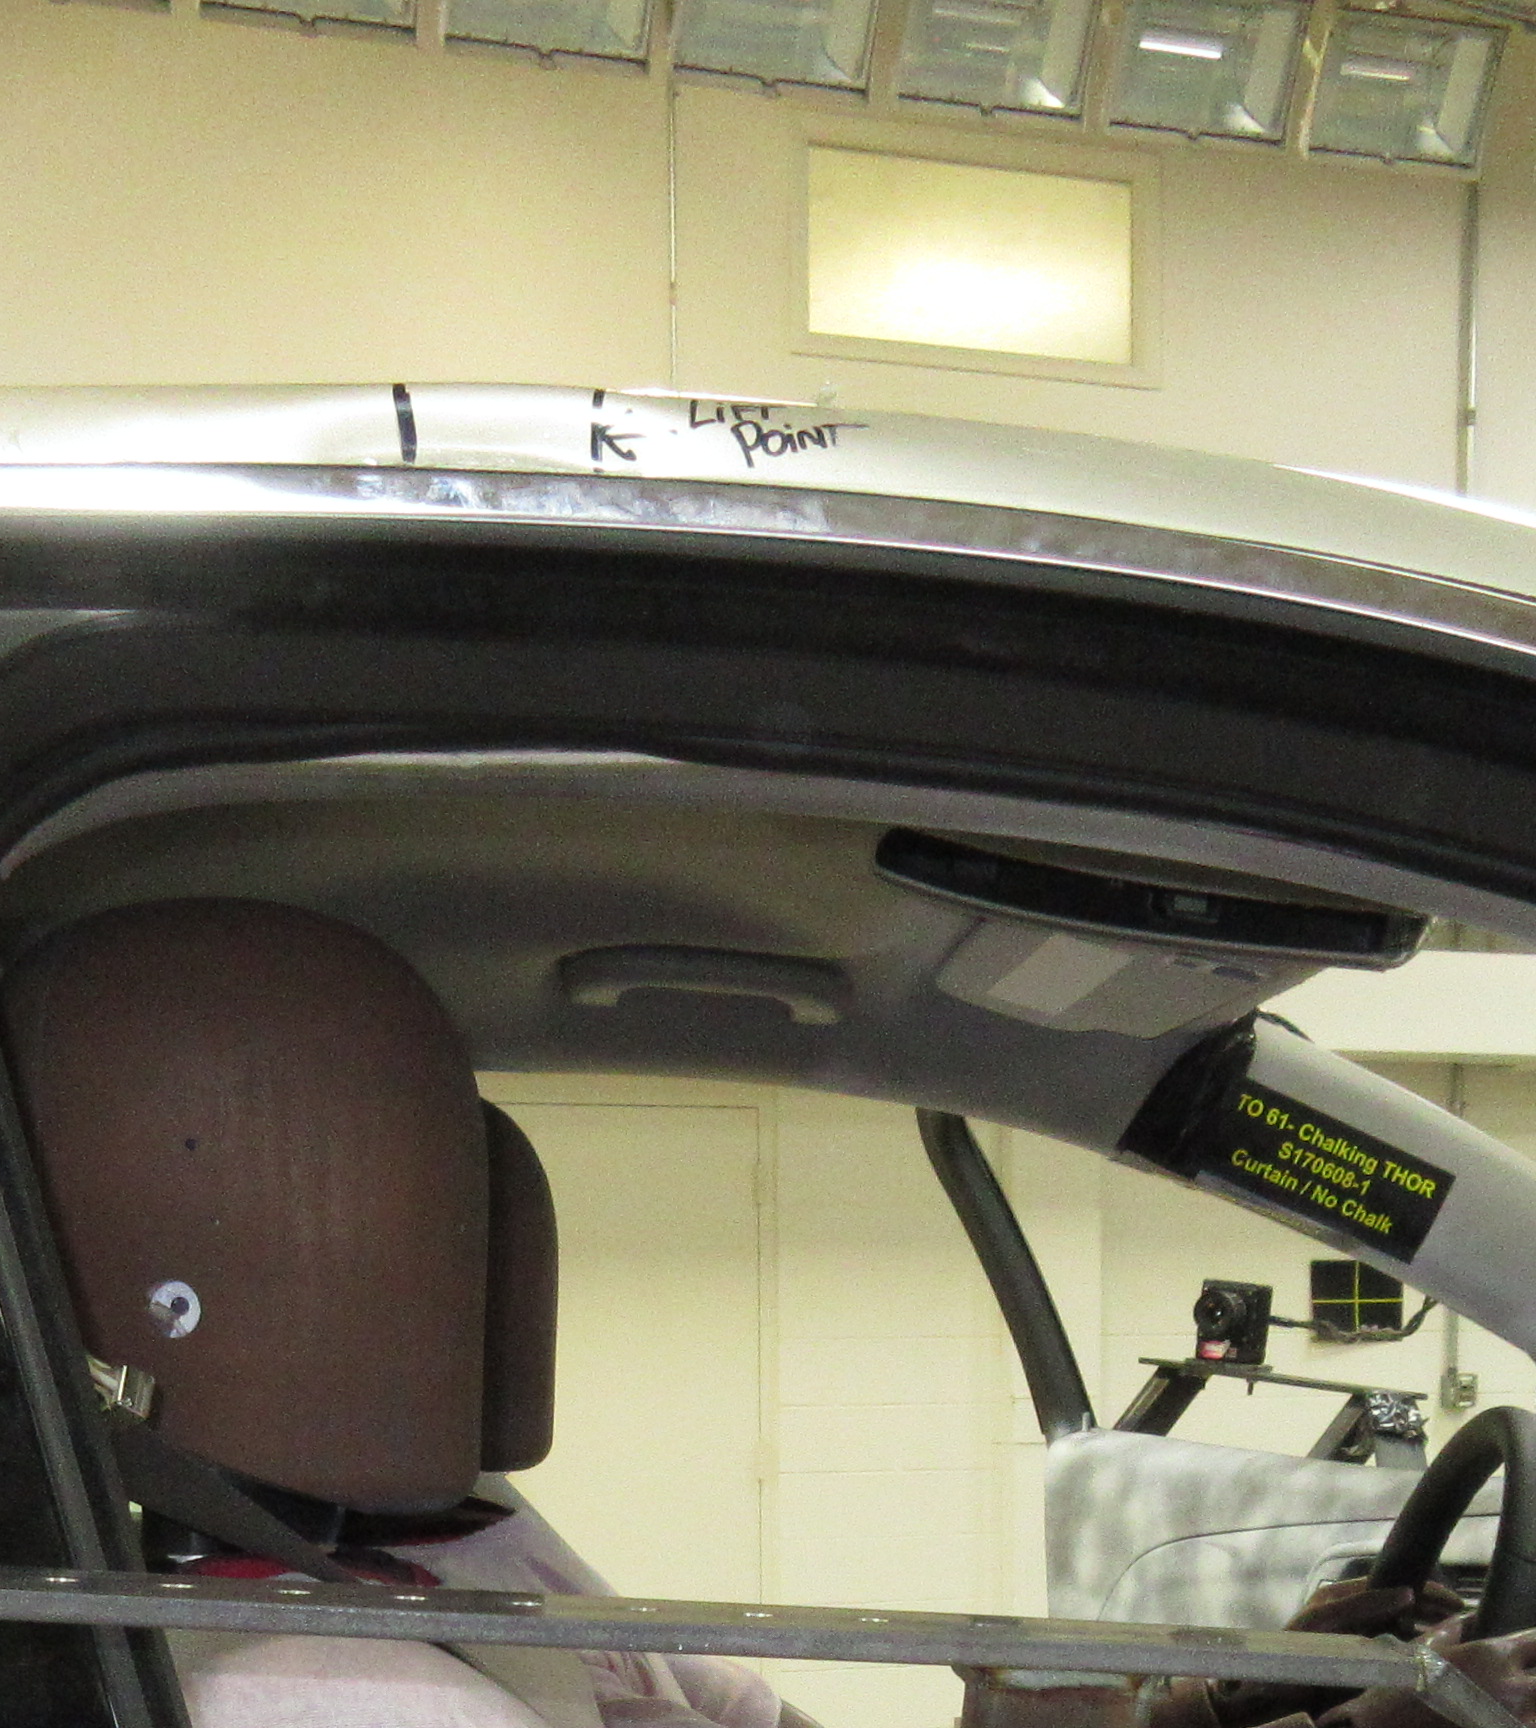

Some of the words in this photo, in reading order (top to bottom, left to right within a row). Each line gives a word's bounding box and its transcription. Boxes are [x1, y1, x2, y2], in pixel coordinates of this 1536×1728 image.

[1237, 1093, 1264, 1118] TO
[1266, 1107, 1296, 1131] 61-
[1298, 1122, 1380, 1176] Chalking
[1382, 1160, 1438, 1199] THOR
[1278, 1142, 1371, 1196] S170608-1
[1231, 1149, 1300, 1190] Curtain
[1311, 1185, 1339, 1209] No
[1340, 1199, 1393, 1234] Chalk
